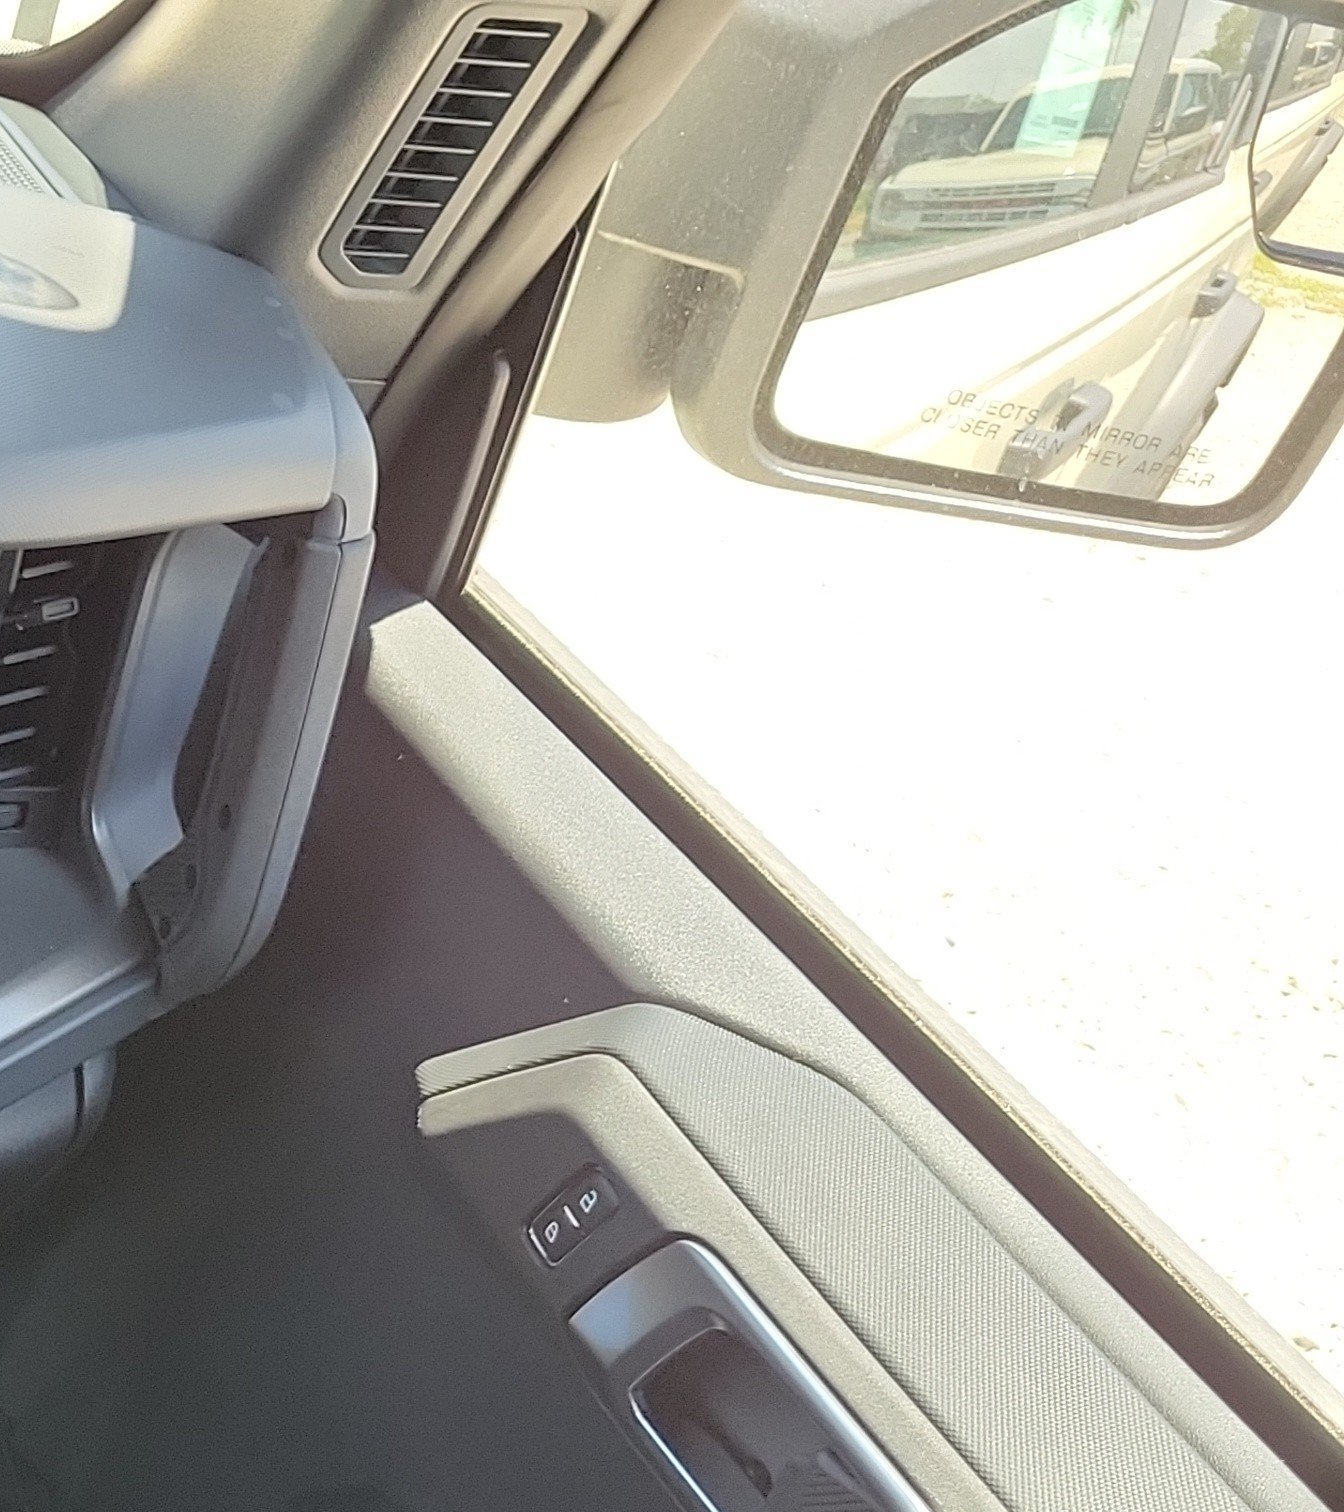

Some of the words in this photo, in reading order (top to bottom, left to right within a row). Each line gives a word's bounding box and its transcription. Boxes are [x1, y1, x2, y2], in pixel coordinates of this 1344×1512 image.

[1013, 429, 1064, 455] THAN
[1075, 443, 1126, 469] THEY
[1132, 456, 1215, 488] APPEAR
[1080, 422, 1162, 452] MIRROR
[1167, 446, 1212, 465] ARE
